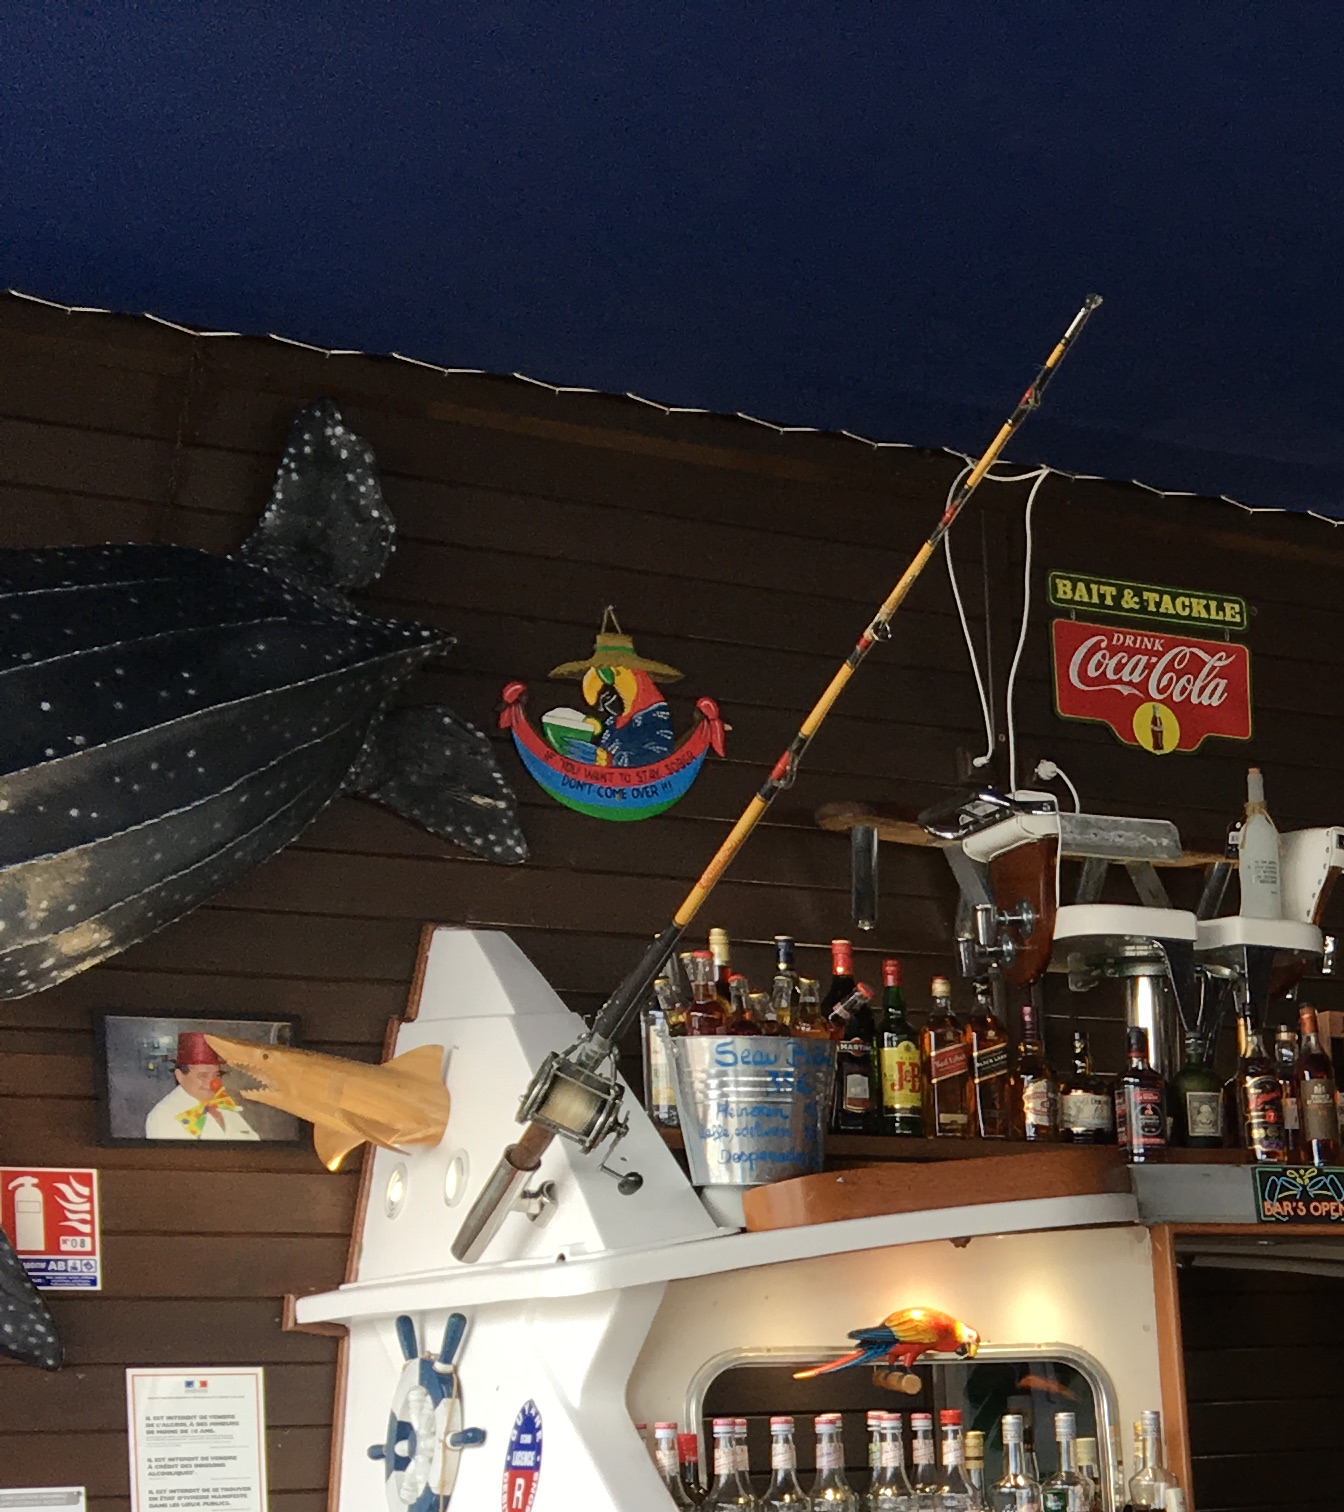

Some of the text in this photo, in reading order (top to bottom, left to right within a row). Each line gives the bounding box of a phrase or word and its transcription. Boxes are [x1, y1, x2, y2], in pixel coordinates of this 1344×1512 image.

[1055, 577, 1242, 623] BAIT & TACKLE
[1111, 632, 1165, 652] DRINK
[1068, 634, 1236, 707] Coca-Cola
[560, 757, 580, 775] YOU
[584, 767, 614, 783] WANT
[619, 772, 632, 784] TO
[635, 767, 660, 783] STAY
[664, 751, 697, 775] SOBER
[561, 775, 593, 796] DON'T
[597, 786, 627, 801] COME
[631, 785, 659, 799] OVER
[1263, 1201, 1307, 1217] BAR'S
[47, 1260, 67, 1271] AB
